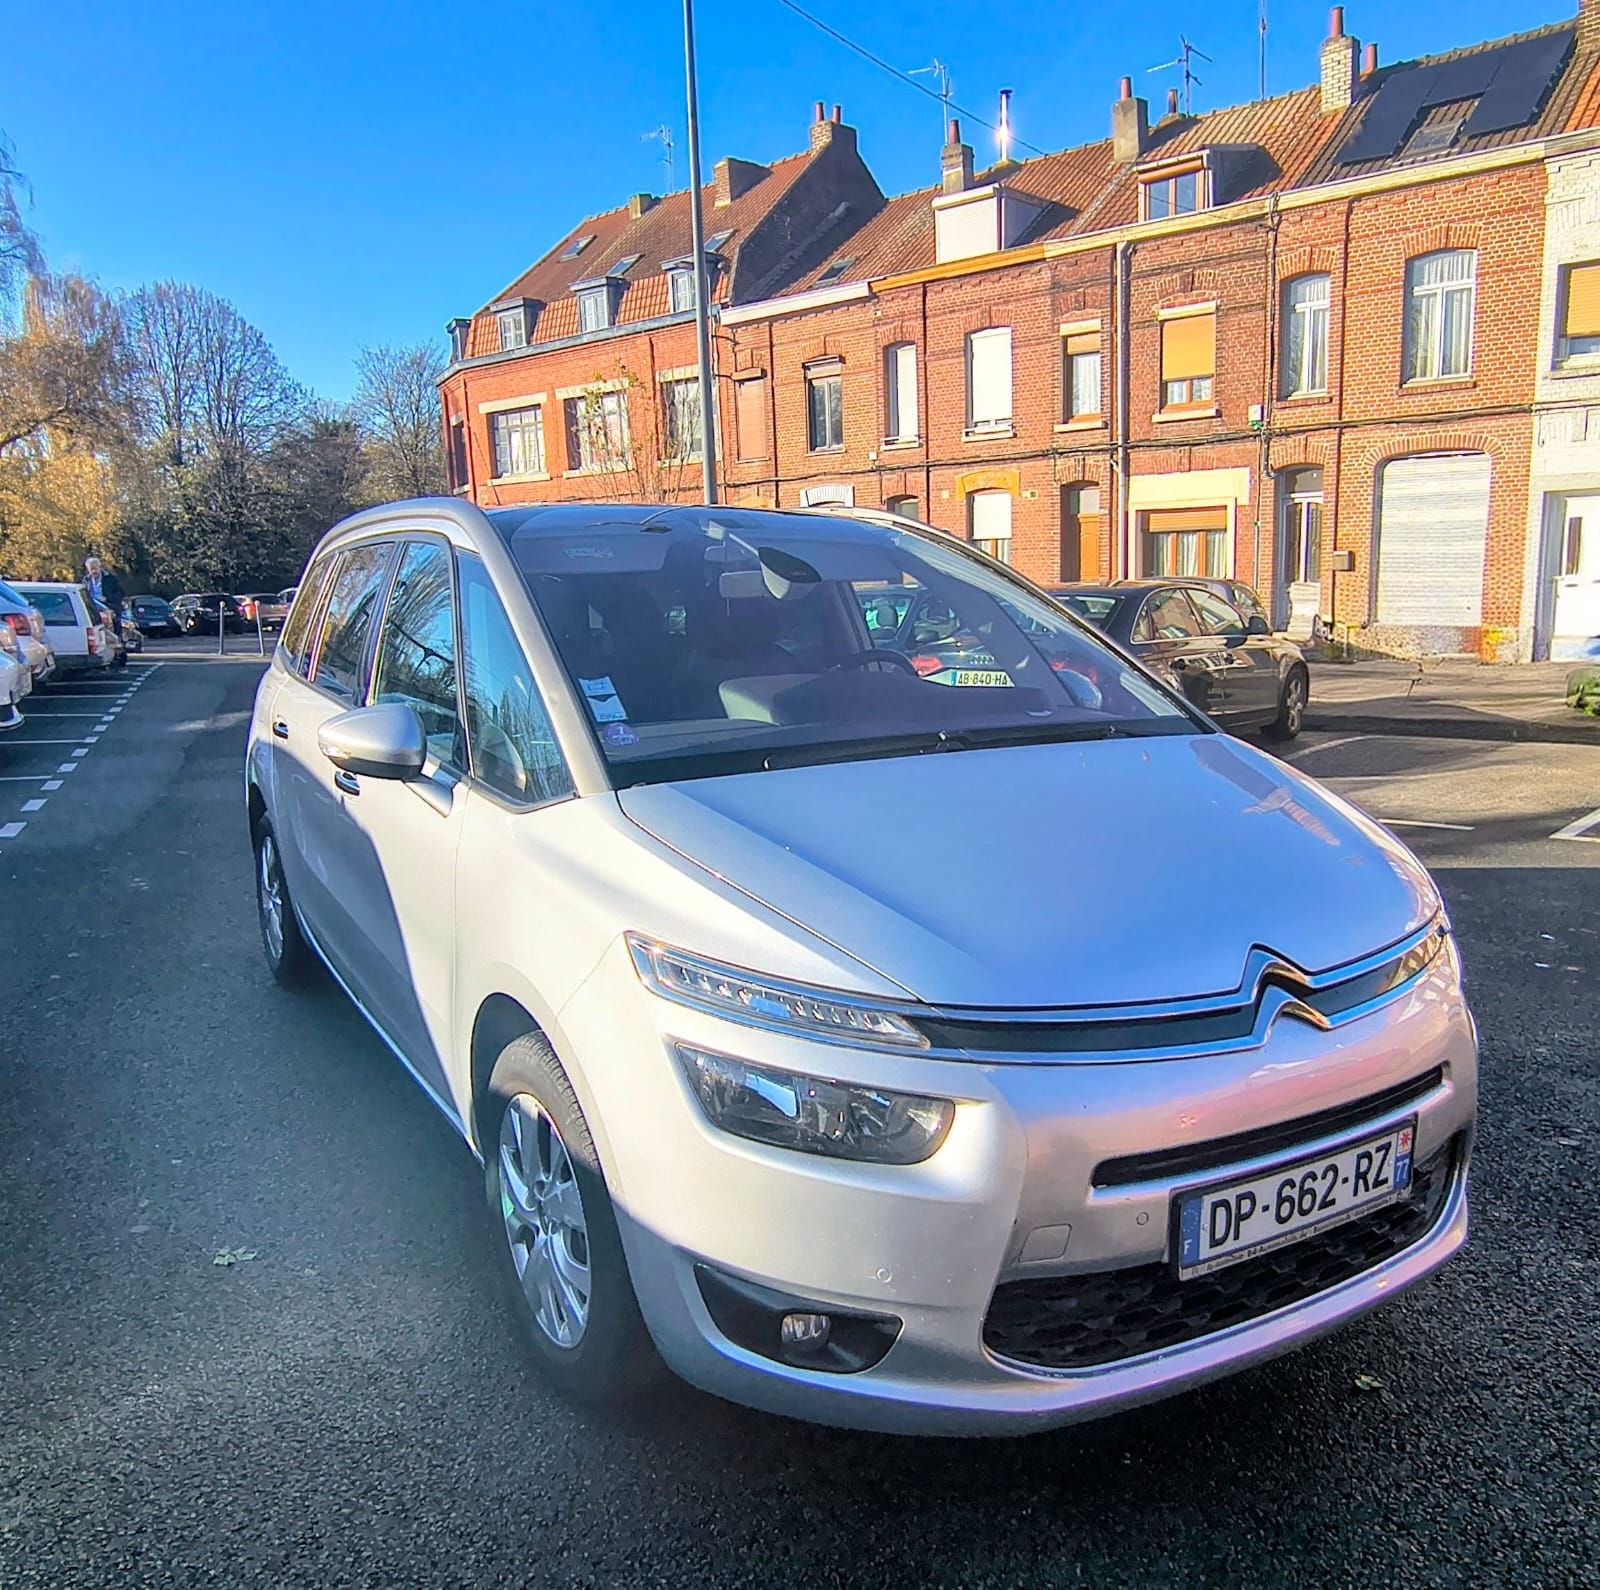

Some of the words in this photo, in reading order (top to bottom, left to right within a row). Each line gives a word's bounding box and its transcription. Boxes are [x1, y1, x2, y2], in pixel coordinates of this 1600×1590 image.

[1396, 1157, 1410, 1183] 77
[1208, 1141, 1392, 1249] DP-662-RZ
[1183, 1238, 1193, 1256] F
